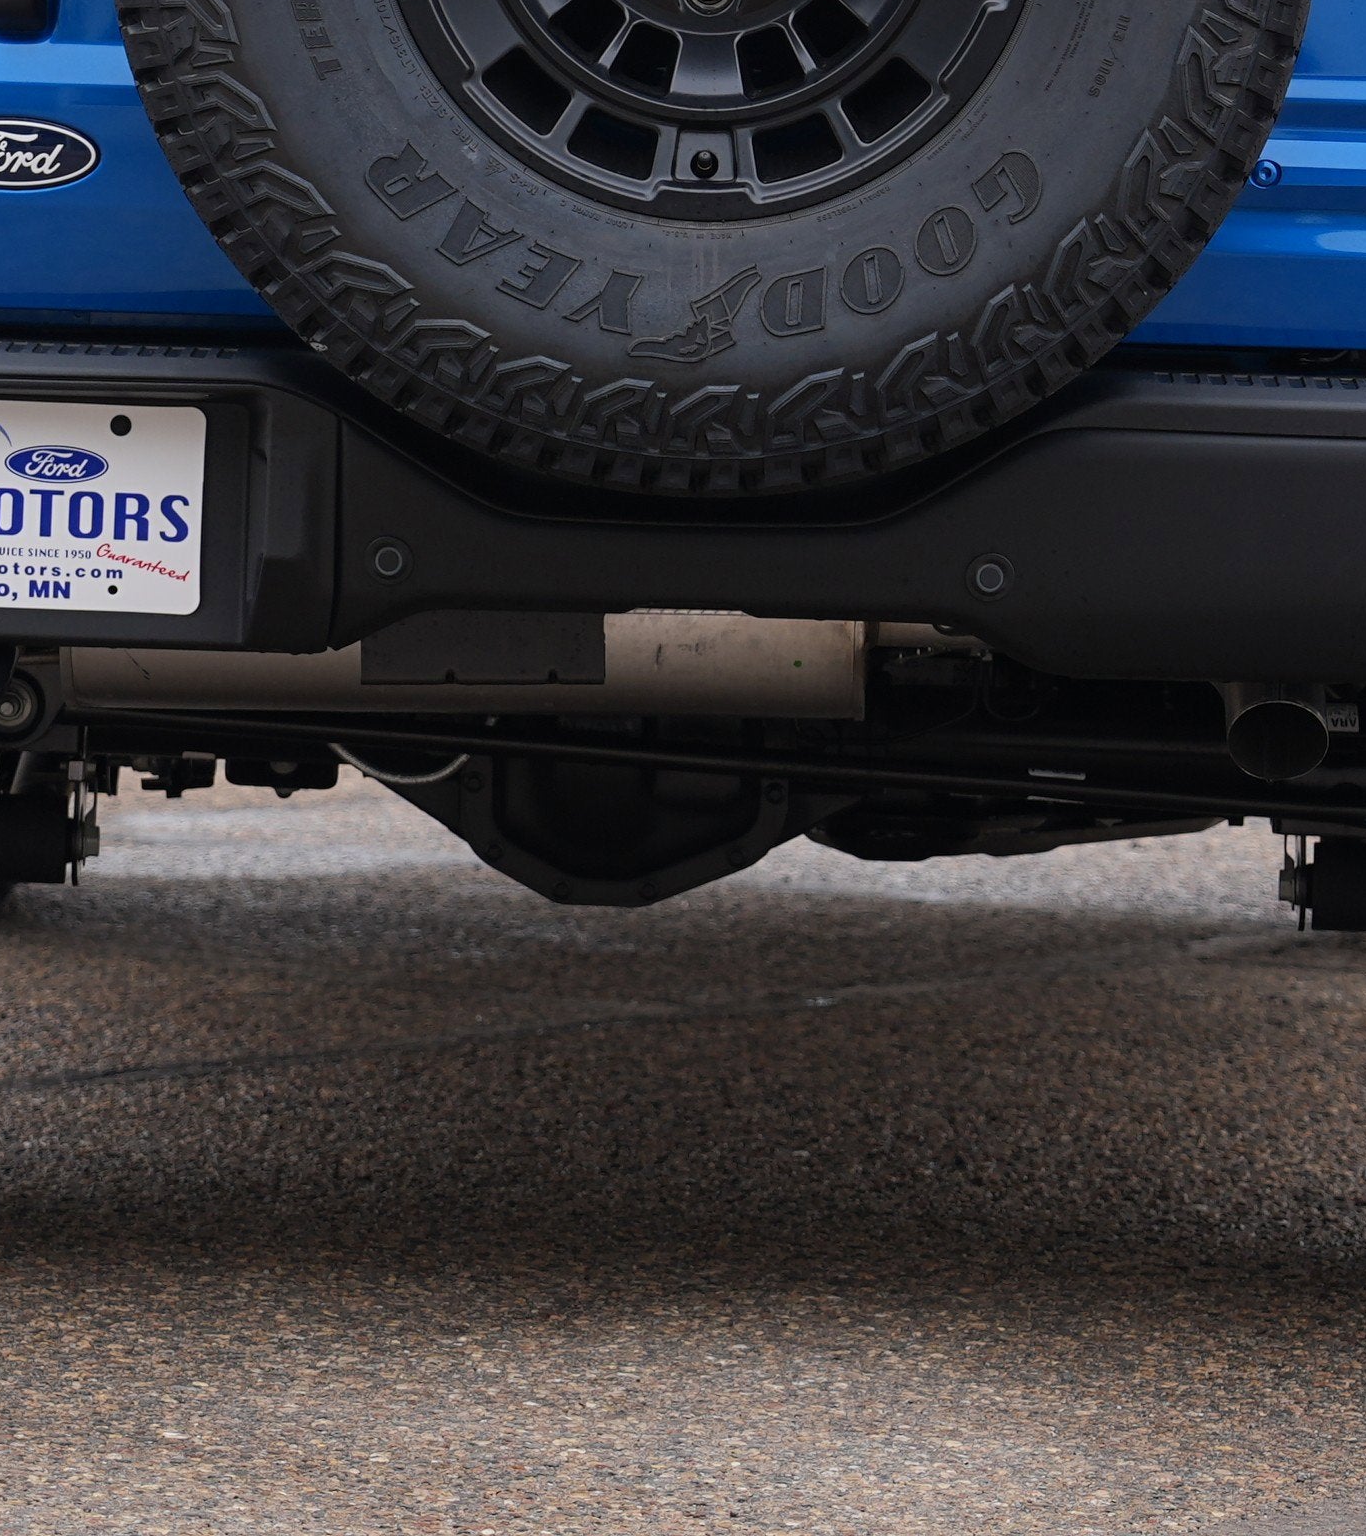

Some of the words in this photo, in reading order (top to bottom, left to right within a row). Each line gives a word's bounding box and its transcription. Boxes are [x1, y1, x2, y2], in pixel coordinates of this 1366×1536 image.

[364, 140, 643, 335] YEAR
[760, 148, 1043, 337] GOOD
[28, 547, 59, 558] SINCE
[65, 549, 92, 559] 1950
[96, 543, 190, 582] Guaranteed
[28, 580, 71, 599] MN
